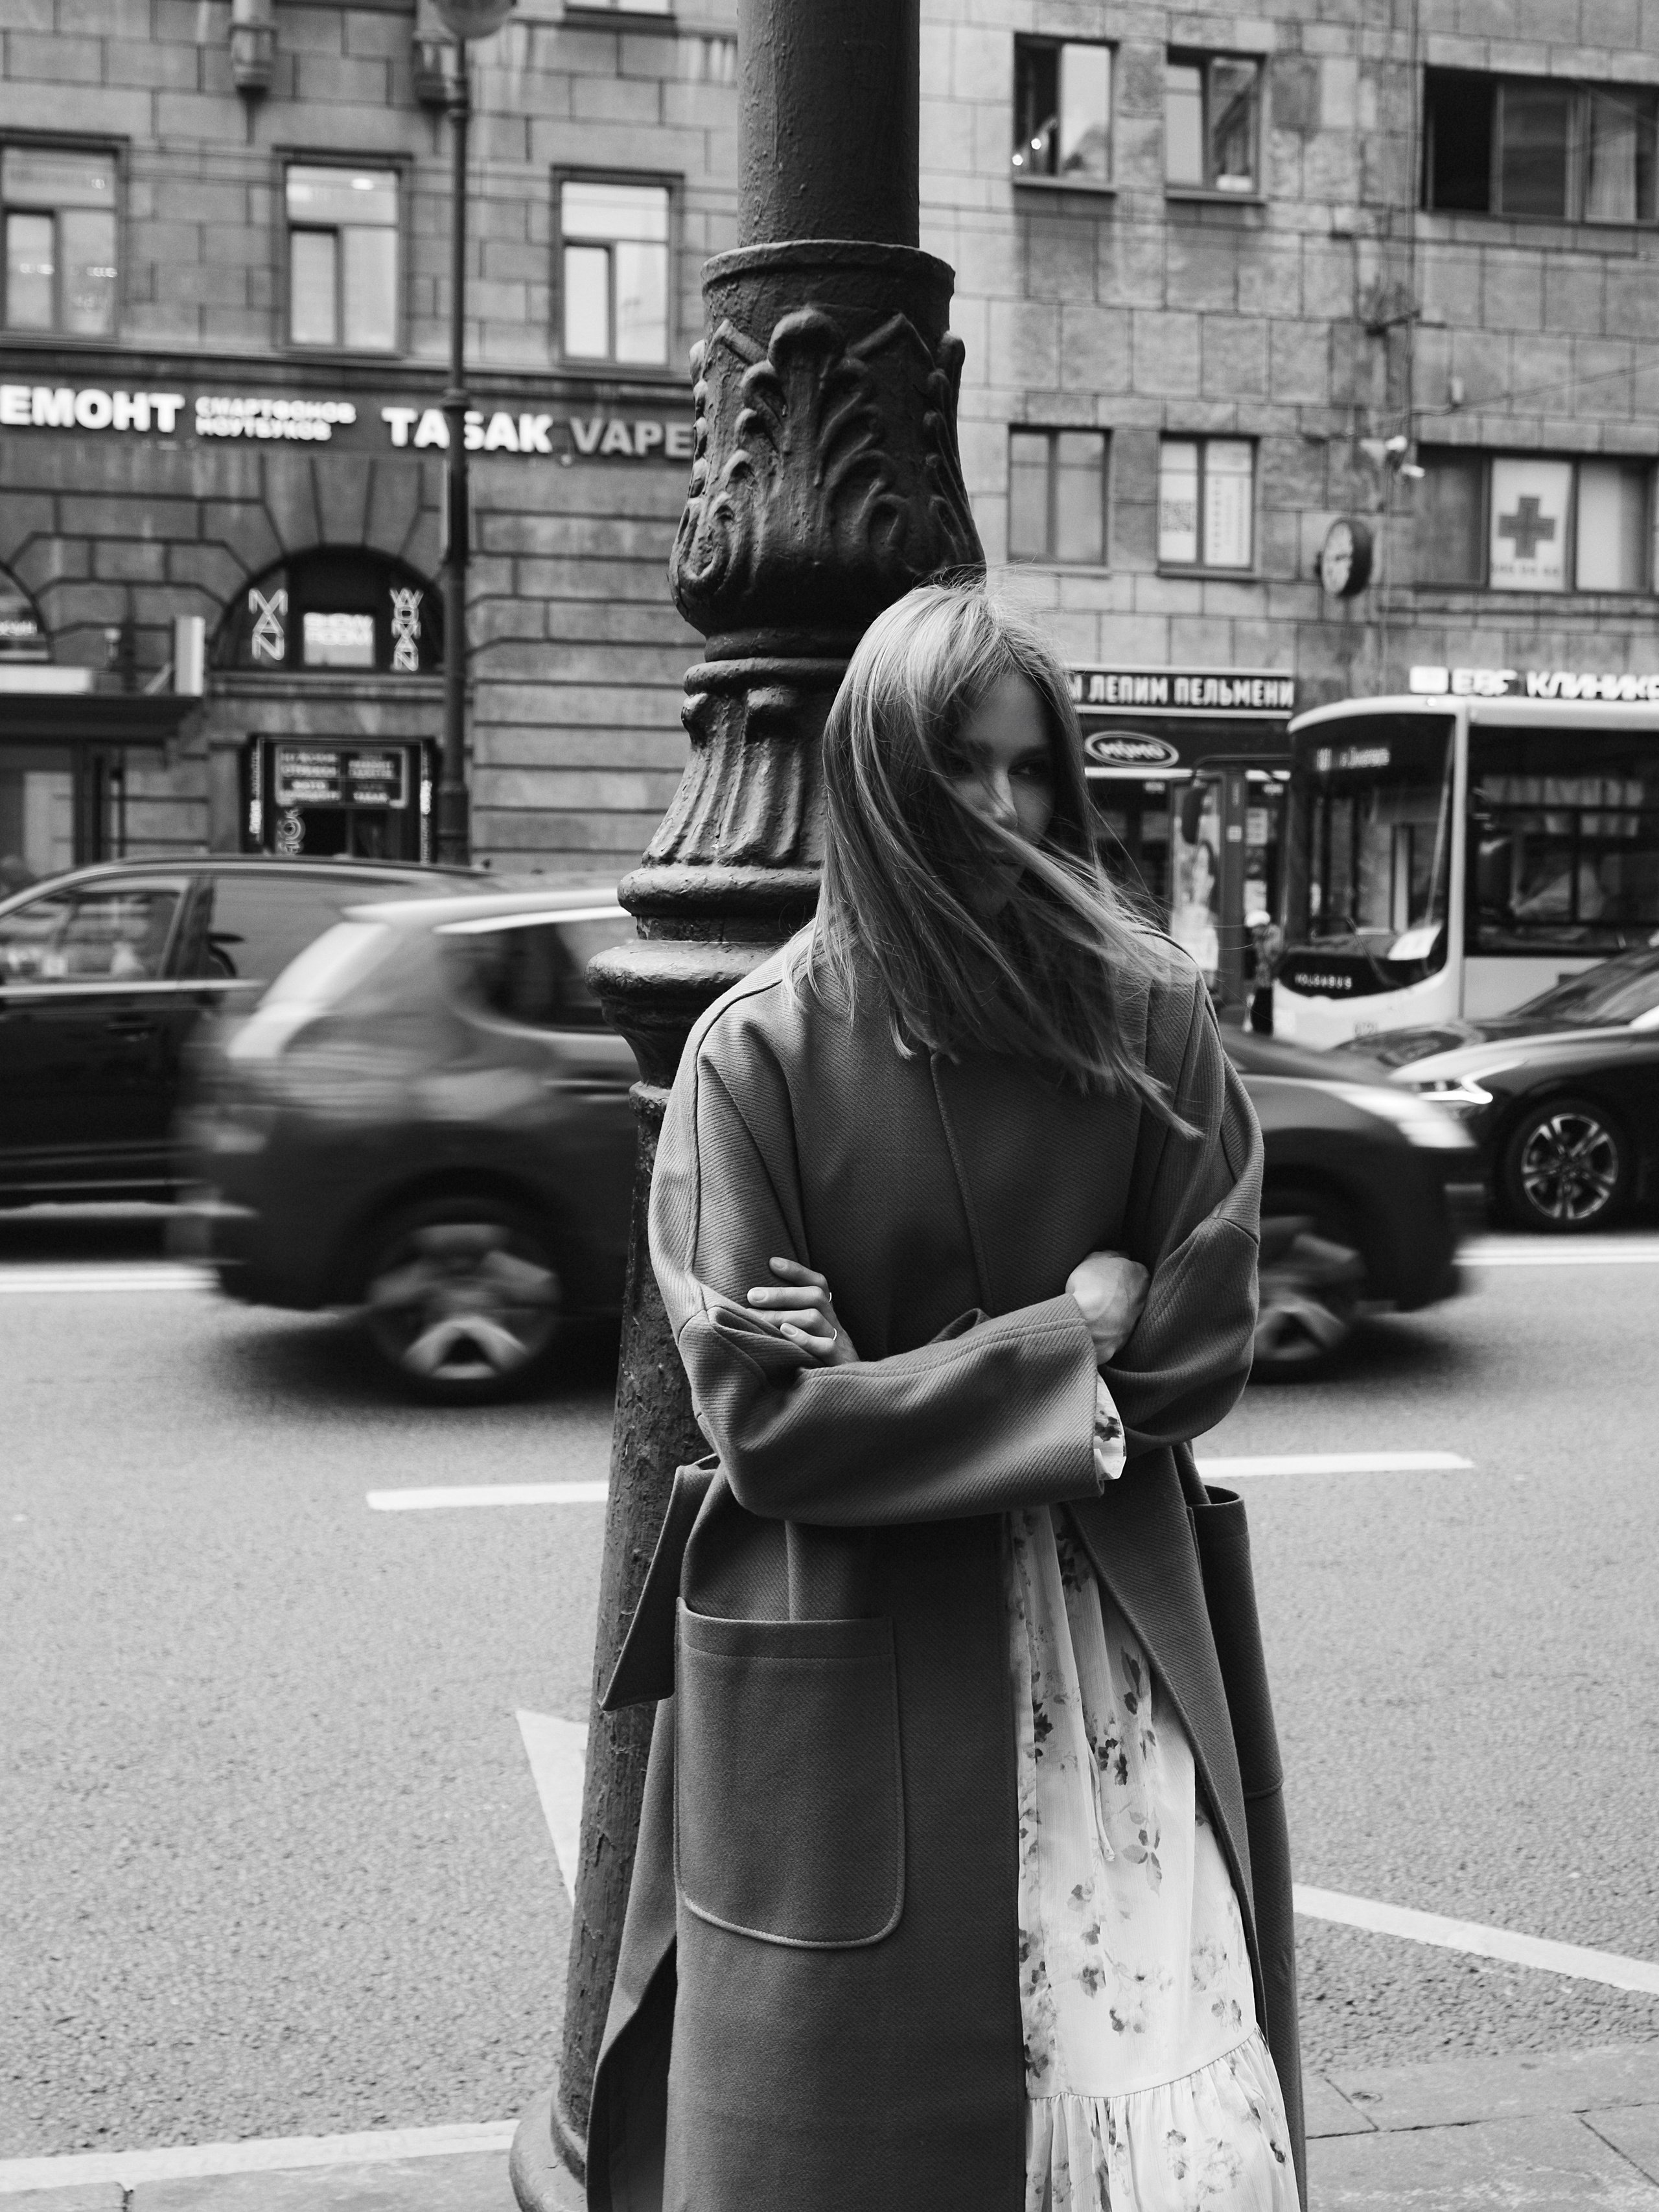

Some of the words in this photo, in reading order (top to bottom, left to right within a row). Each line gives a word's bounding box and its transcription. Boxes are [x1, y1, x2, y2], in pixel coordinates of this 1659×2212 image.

[0, 384, 185, 433] ЕМОНТ
[381, 406, 553, 454] ТАБАК
[570, 417, 694, 457] VAPE
[1174, 677, 1294, 708] ПЕЛЬМЕНИ
